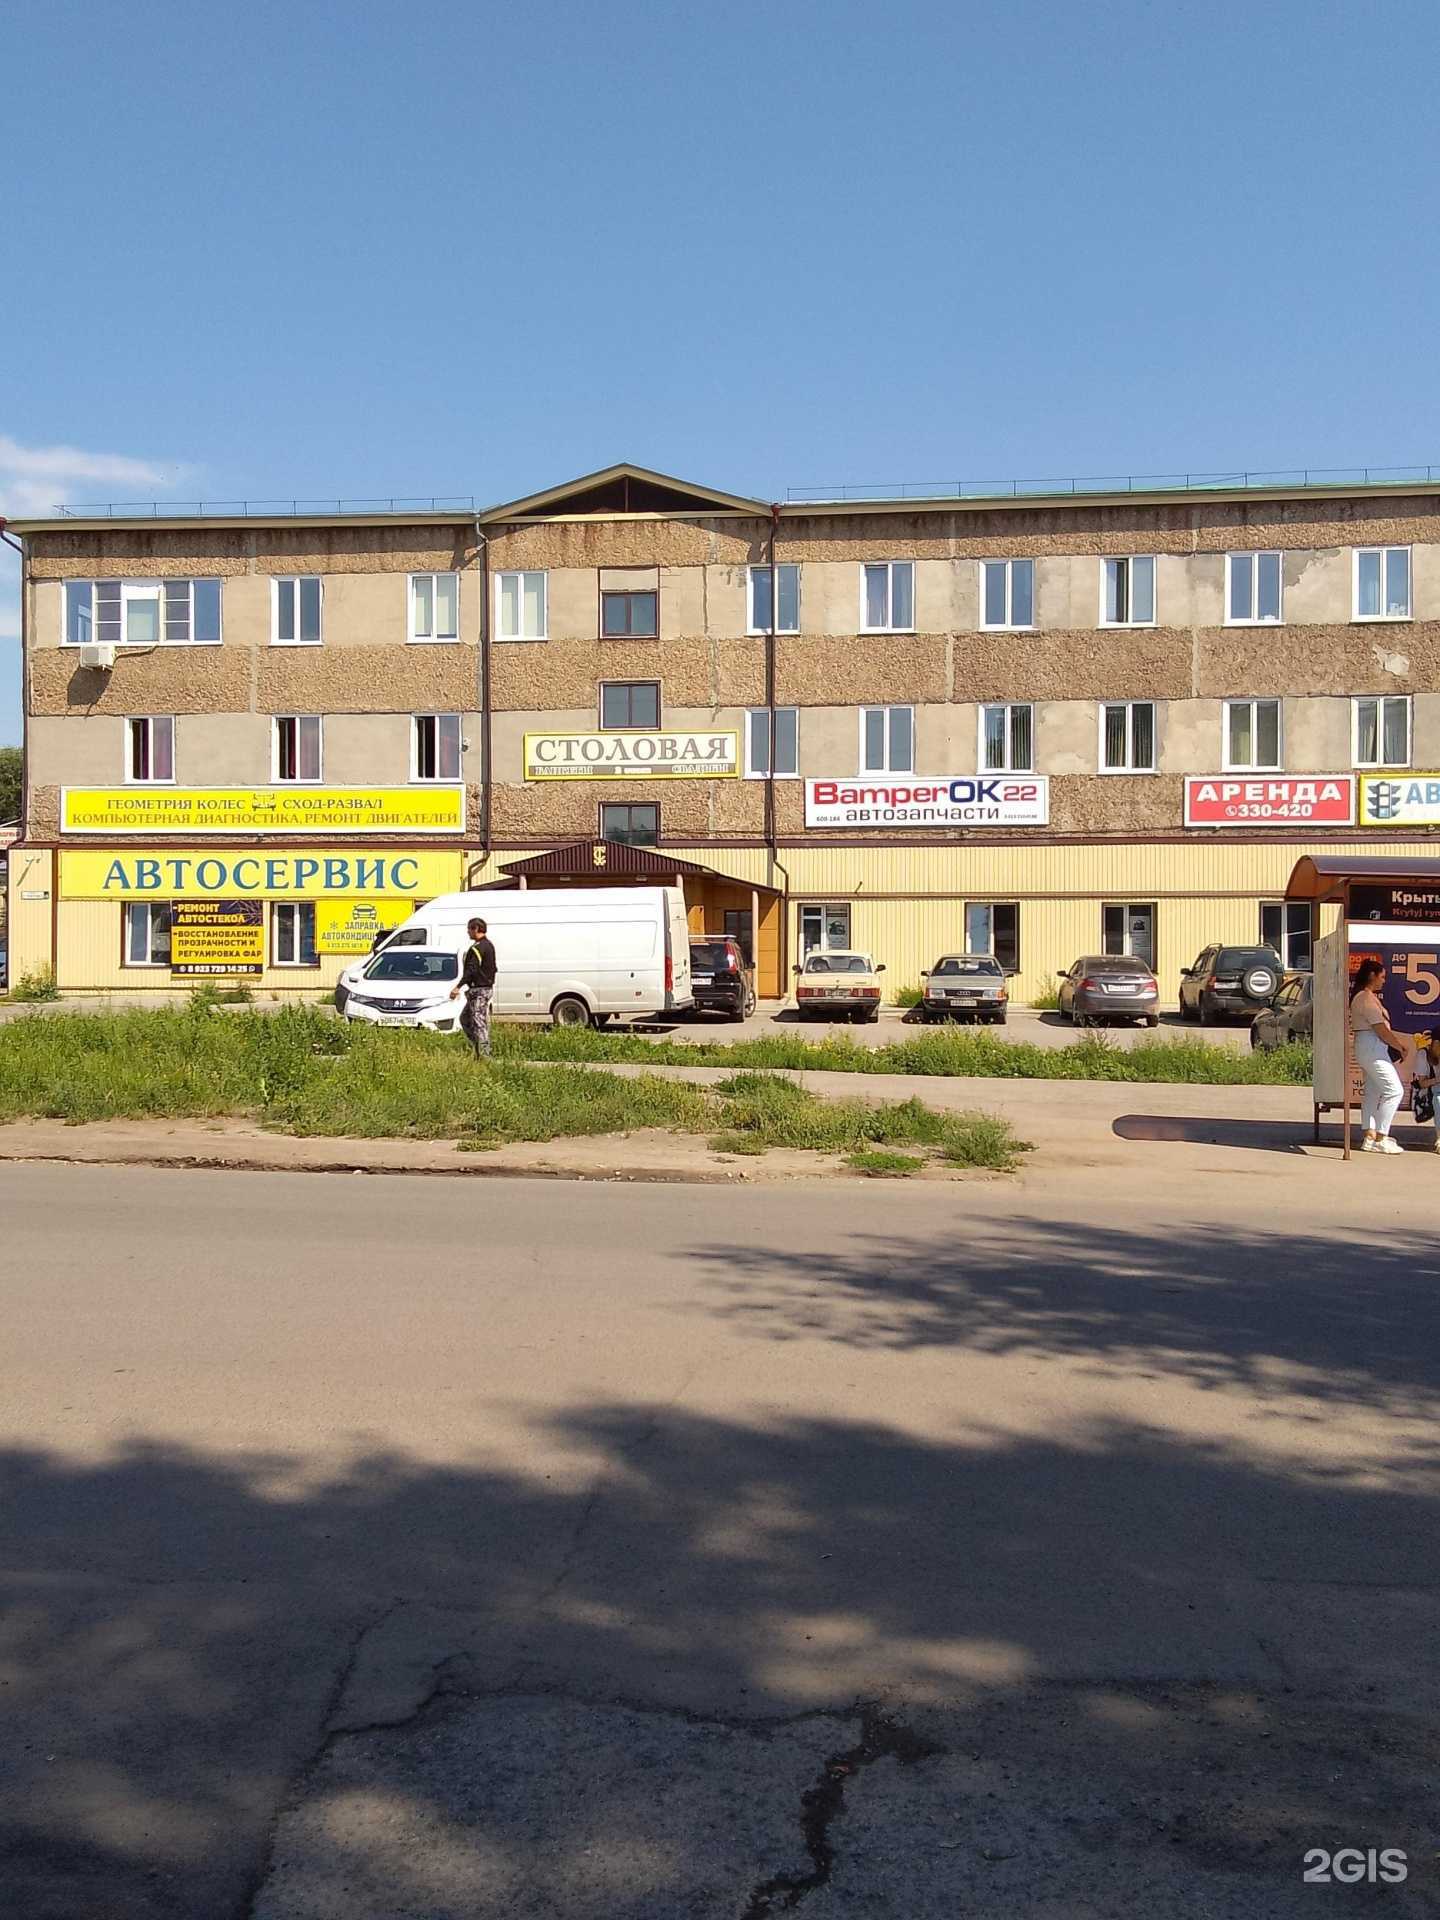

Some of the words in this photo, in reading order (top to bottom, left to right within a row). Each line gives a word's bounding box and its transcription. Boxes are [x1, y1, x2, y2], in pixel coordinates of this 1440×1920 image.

[535, 737, 729, 762] СТОЛОВАЯ
[1196, 783, 1342, 804] АРЕНДА
[107, 799, 192, 810] ГЕОМЕТРИЯ
[197, 799, 246, 810] КОЛЕС
[282, 798, 383, 809] СХОД-РАЗВАЛ
[1238, 803, 1313, 817] 330-420
[72, 813, 190, 824] КОМПЬЮТЕРНАЯ
[193, 813, 302, 825] ДИАГНОСТИКА,
[305, 812, 360, 824] РЕМОНТ
[366, 812, 457, 824] ДВИГАТЕЛЕЙ
[846, 807, 1000, 821] автозапчасти
[102, 858, 419, 891] АВТОСЕРВИС
[177, 913, 246, 923] АВТОСТЕКОЛ
[344, 921, 385, 930] ЗАПРАВКА
[321, 931, 376, 942] АВТОКОНДИЦ
[178, 939, 247, 947] ПРОЗРАЧНОСТИ
[248, 939, 256, 947] И
[178, 950, 241, 958] РЕГУЛИРОВКА
[242, 950, 262, 958] ФАР
[1392, 953, 1407, 963] до
